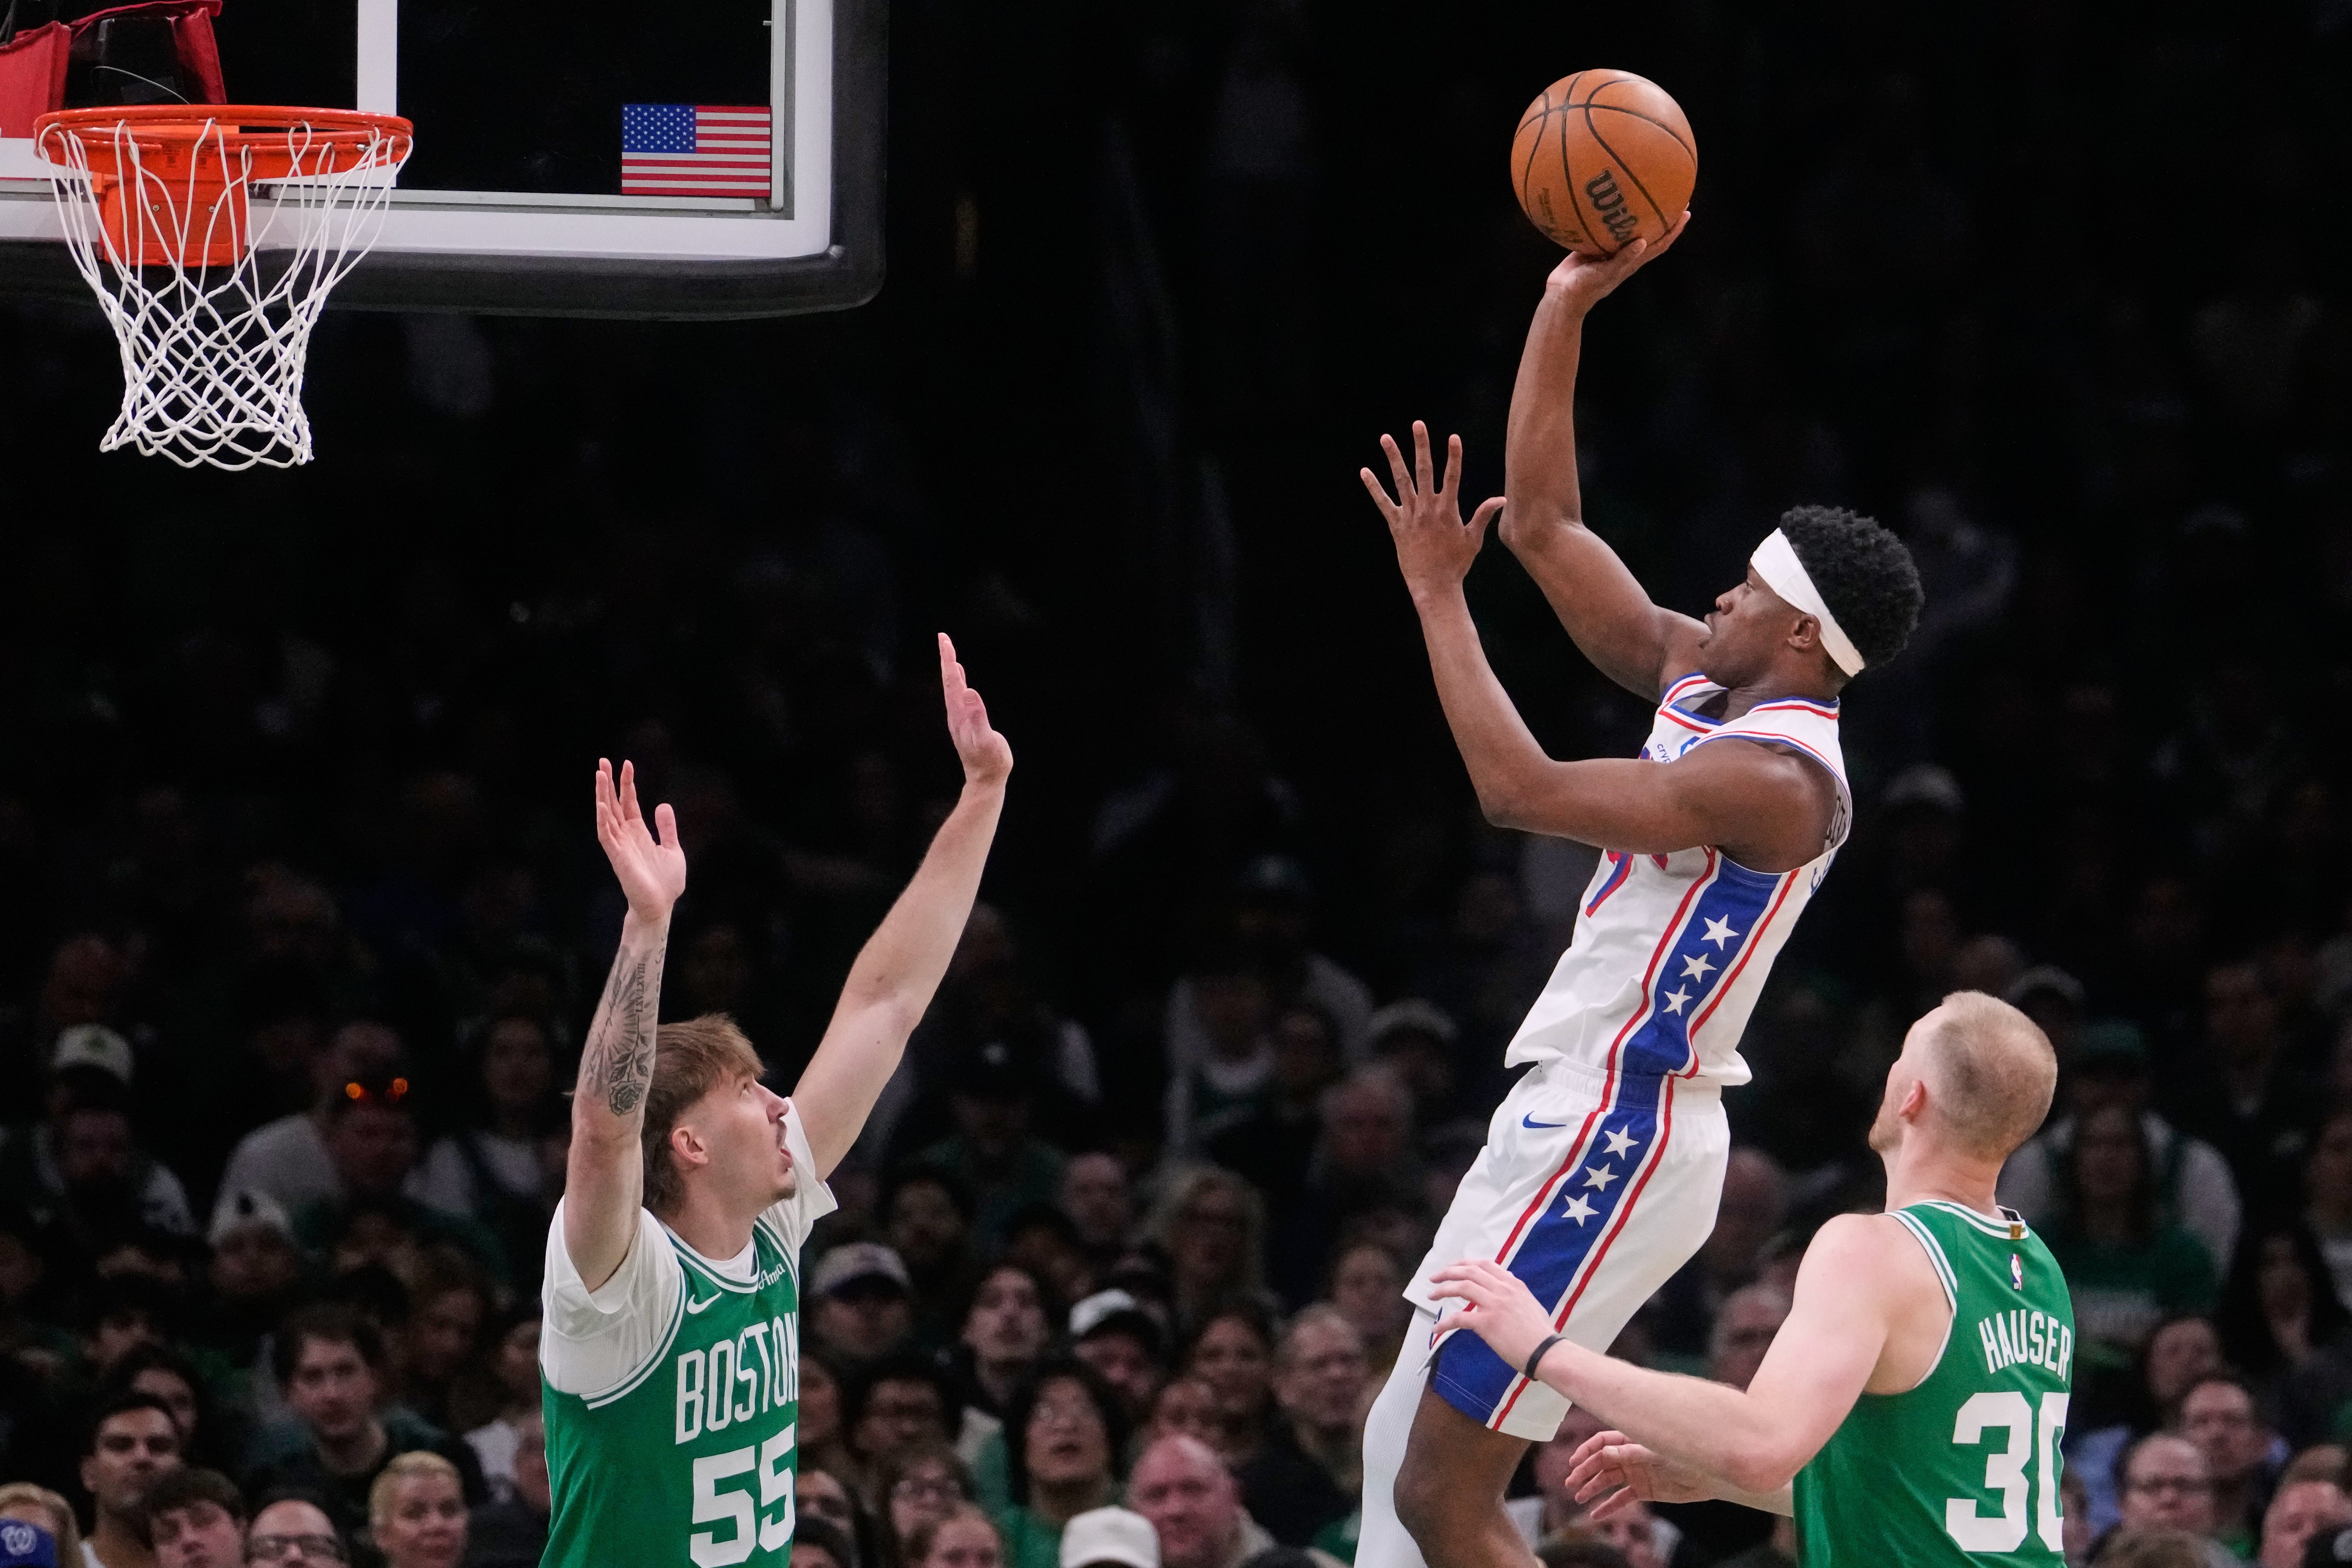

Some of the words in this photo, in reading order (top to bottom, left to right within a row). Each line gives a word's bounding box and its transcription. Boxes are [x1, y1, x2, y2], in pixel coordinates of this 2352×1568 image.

[1585, 167, 1638, 242] Wils
[1657, 743, 1672, 763] cryp
[675, 1312, 799, 1445] BOSTON
[1978, 1309, 2071, 1382] HAUSER
[690, 1422, 796, 1568] 55
[1945, 1391, 2069, 1553] 30
